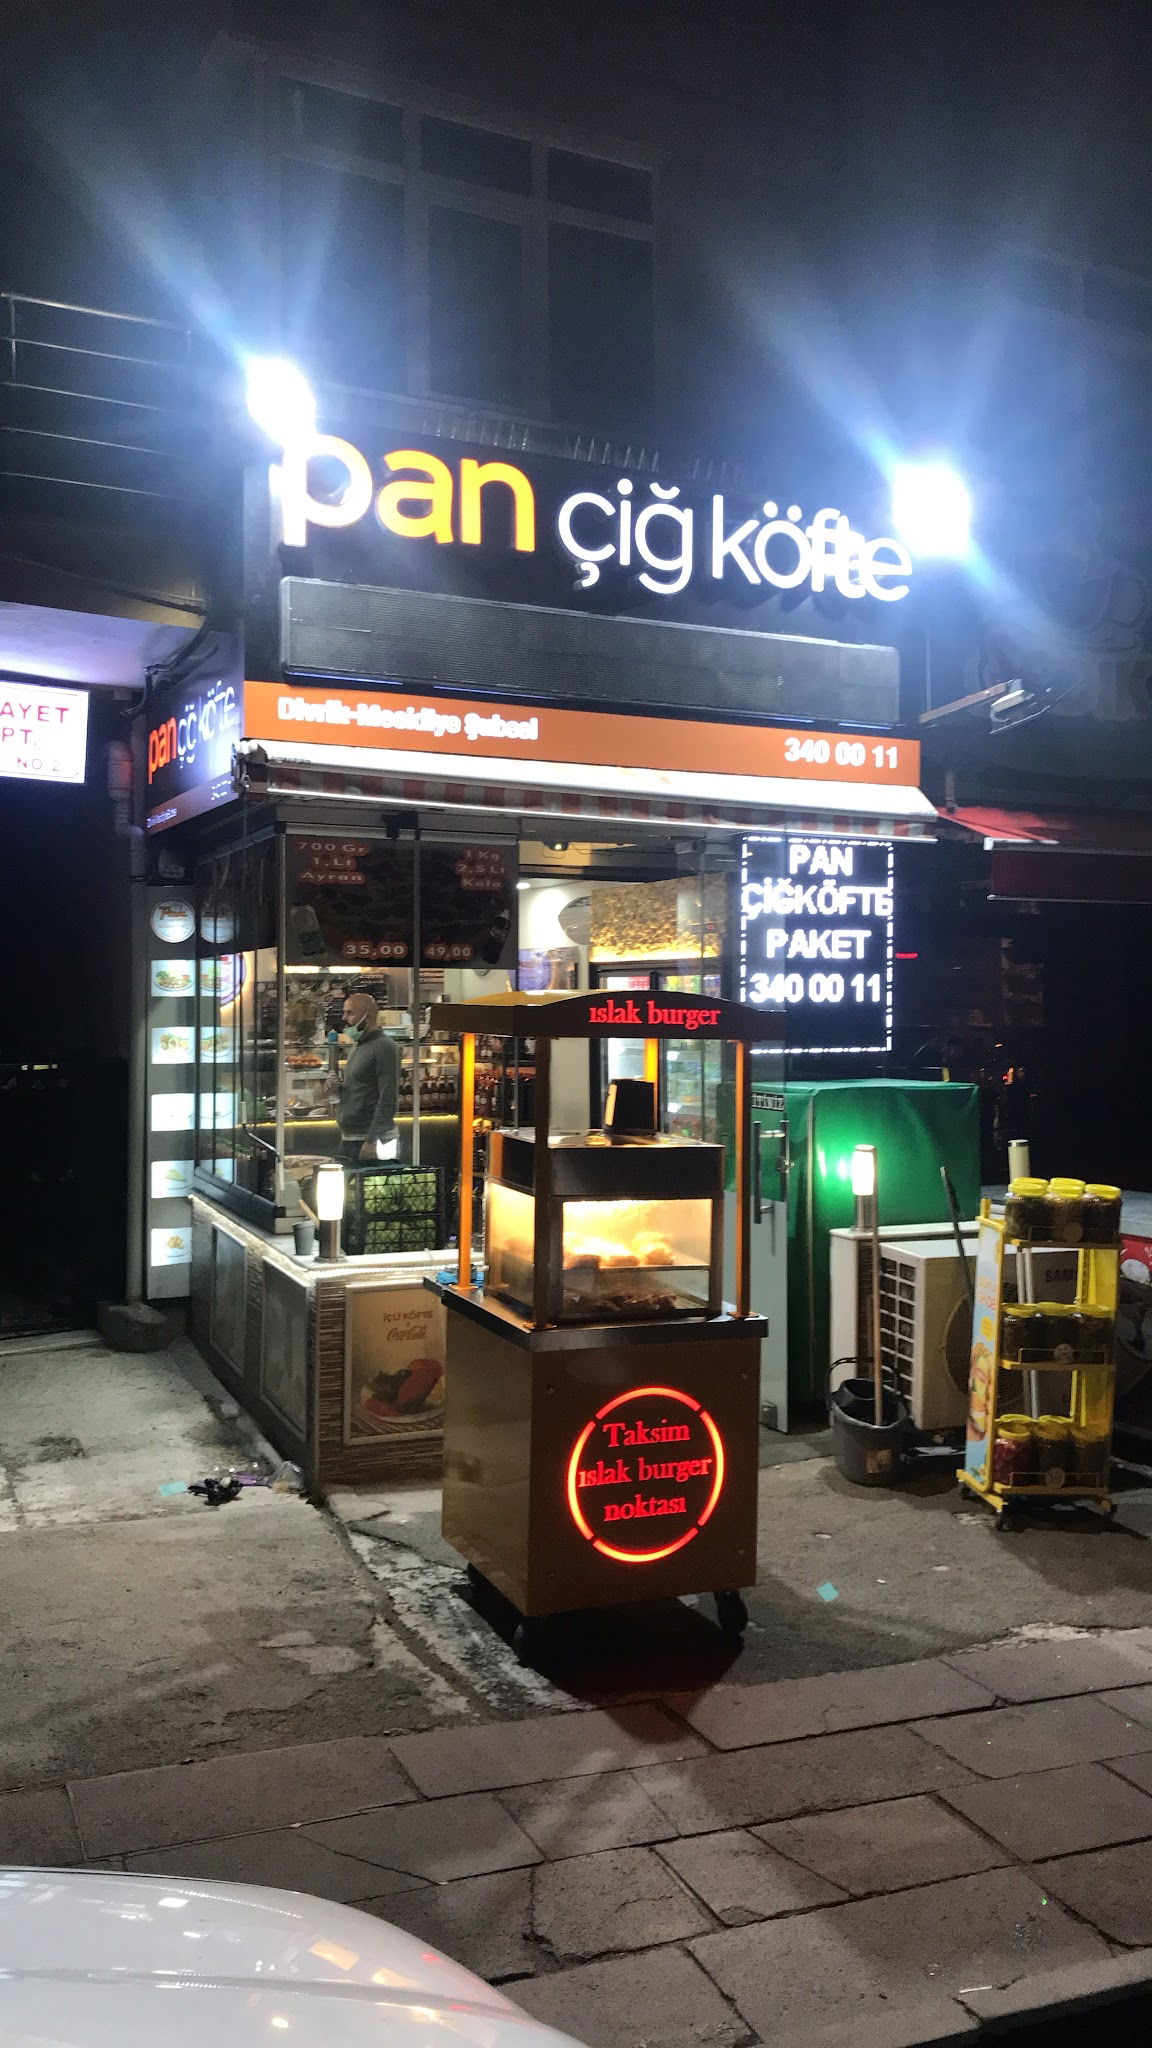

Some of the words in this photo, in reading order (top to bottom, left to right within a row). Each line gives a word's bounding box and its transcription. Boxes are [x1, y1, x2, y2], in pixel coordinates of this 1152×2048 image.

[270, 433, 535, 552] pan
[557, 478, 694, 595] çiğ
[712, 494, 914, 602] köfte
[147, 716, 177, 785] pan
[784, 737, 830, 765] 340
[834, 741, 866, 767] 00
[872, 744, 898, 769] 11
[299, 842, 336, 851] 700
[342, 844, 368, 853] Gr
[789, 844, 853, 876] PAN
[300, 871, 363, 882] Ayran
[345, 945, 405, 957] 35,00
[426, 947, 472, 958] 49,00
[766, 928, 872, 959] PAKET
[749, 972, 804, 1003] 340
[808, 973, 845, 1003] 00
[850, 973, 881, 1003] 11
[646, 1000, 721, 1031] burger
[602, 1418, 691, 1448] Taksim
[637, 1457, 713, 1483] burger
[603, 1493, 688, 1522] noktası
